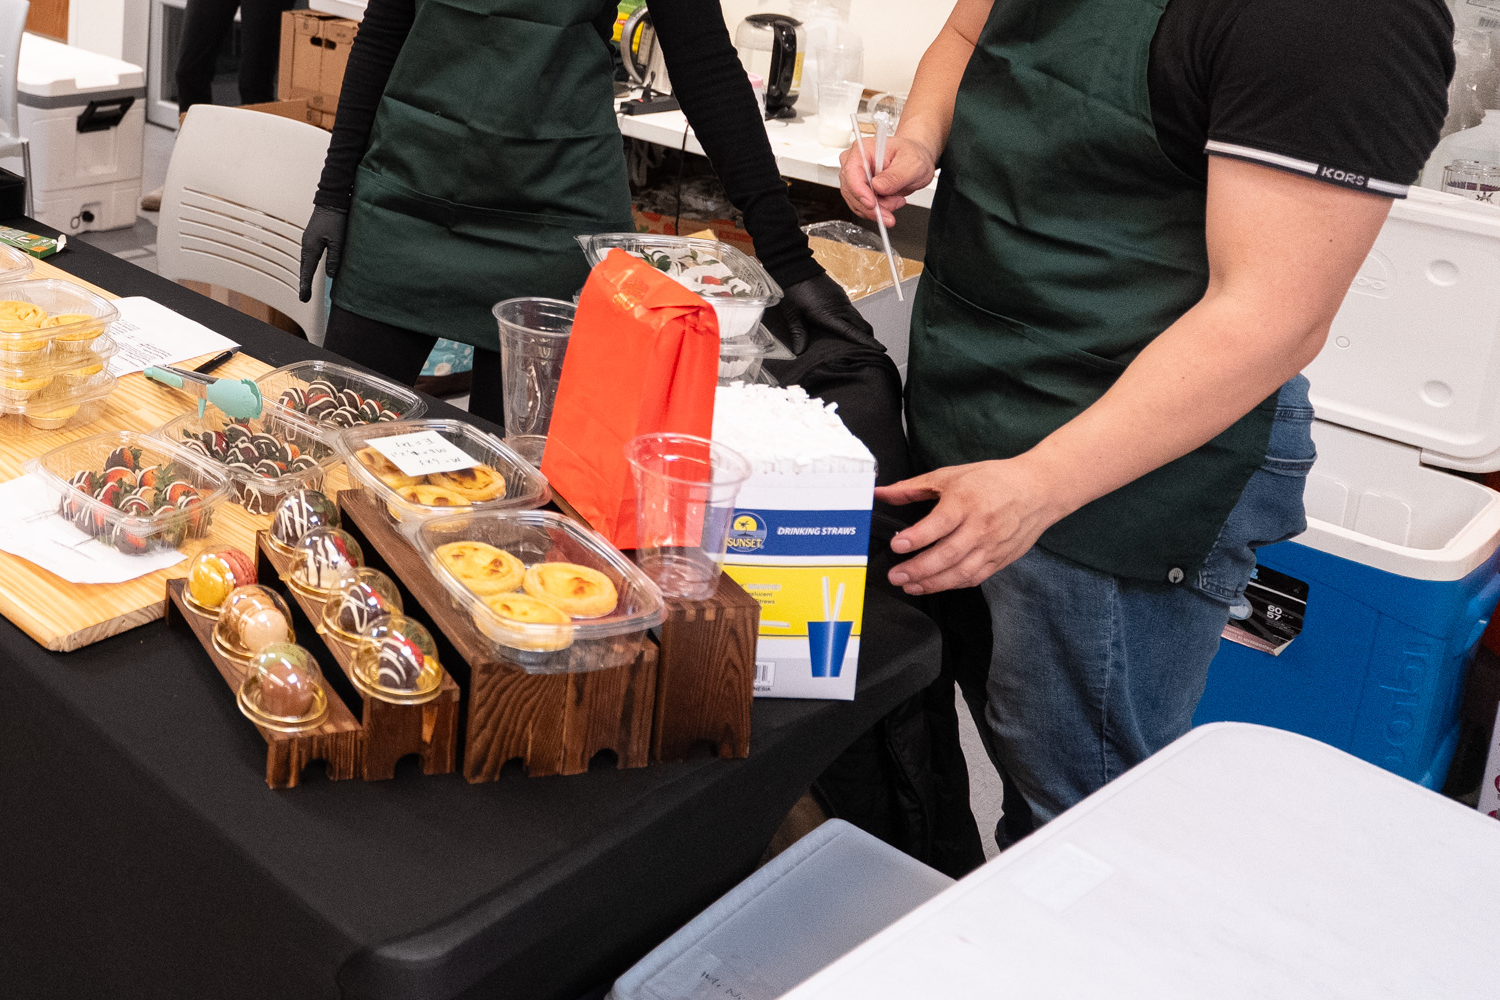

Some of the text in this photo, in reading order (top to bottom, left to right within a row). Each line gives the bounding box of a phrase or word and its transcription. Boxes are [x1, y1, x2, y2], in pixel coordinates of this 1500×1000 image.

[1321, 166, 1365, 186] KORS
[776, 526, 857, 537] DRINKING STRAWS
[727, 536, 762, 549] SUNSET
[1267, 604, 1283, 615] 60
[1266, 610, 1282, 621] 57
